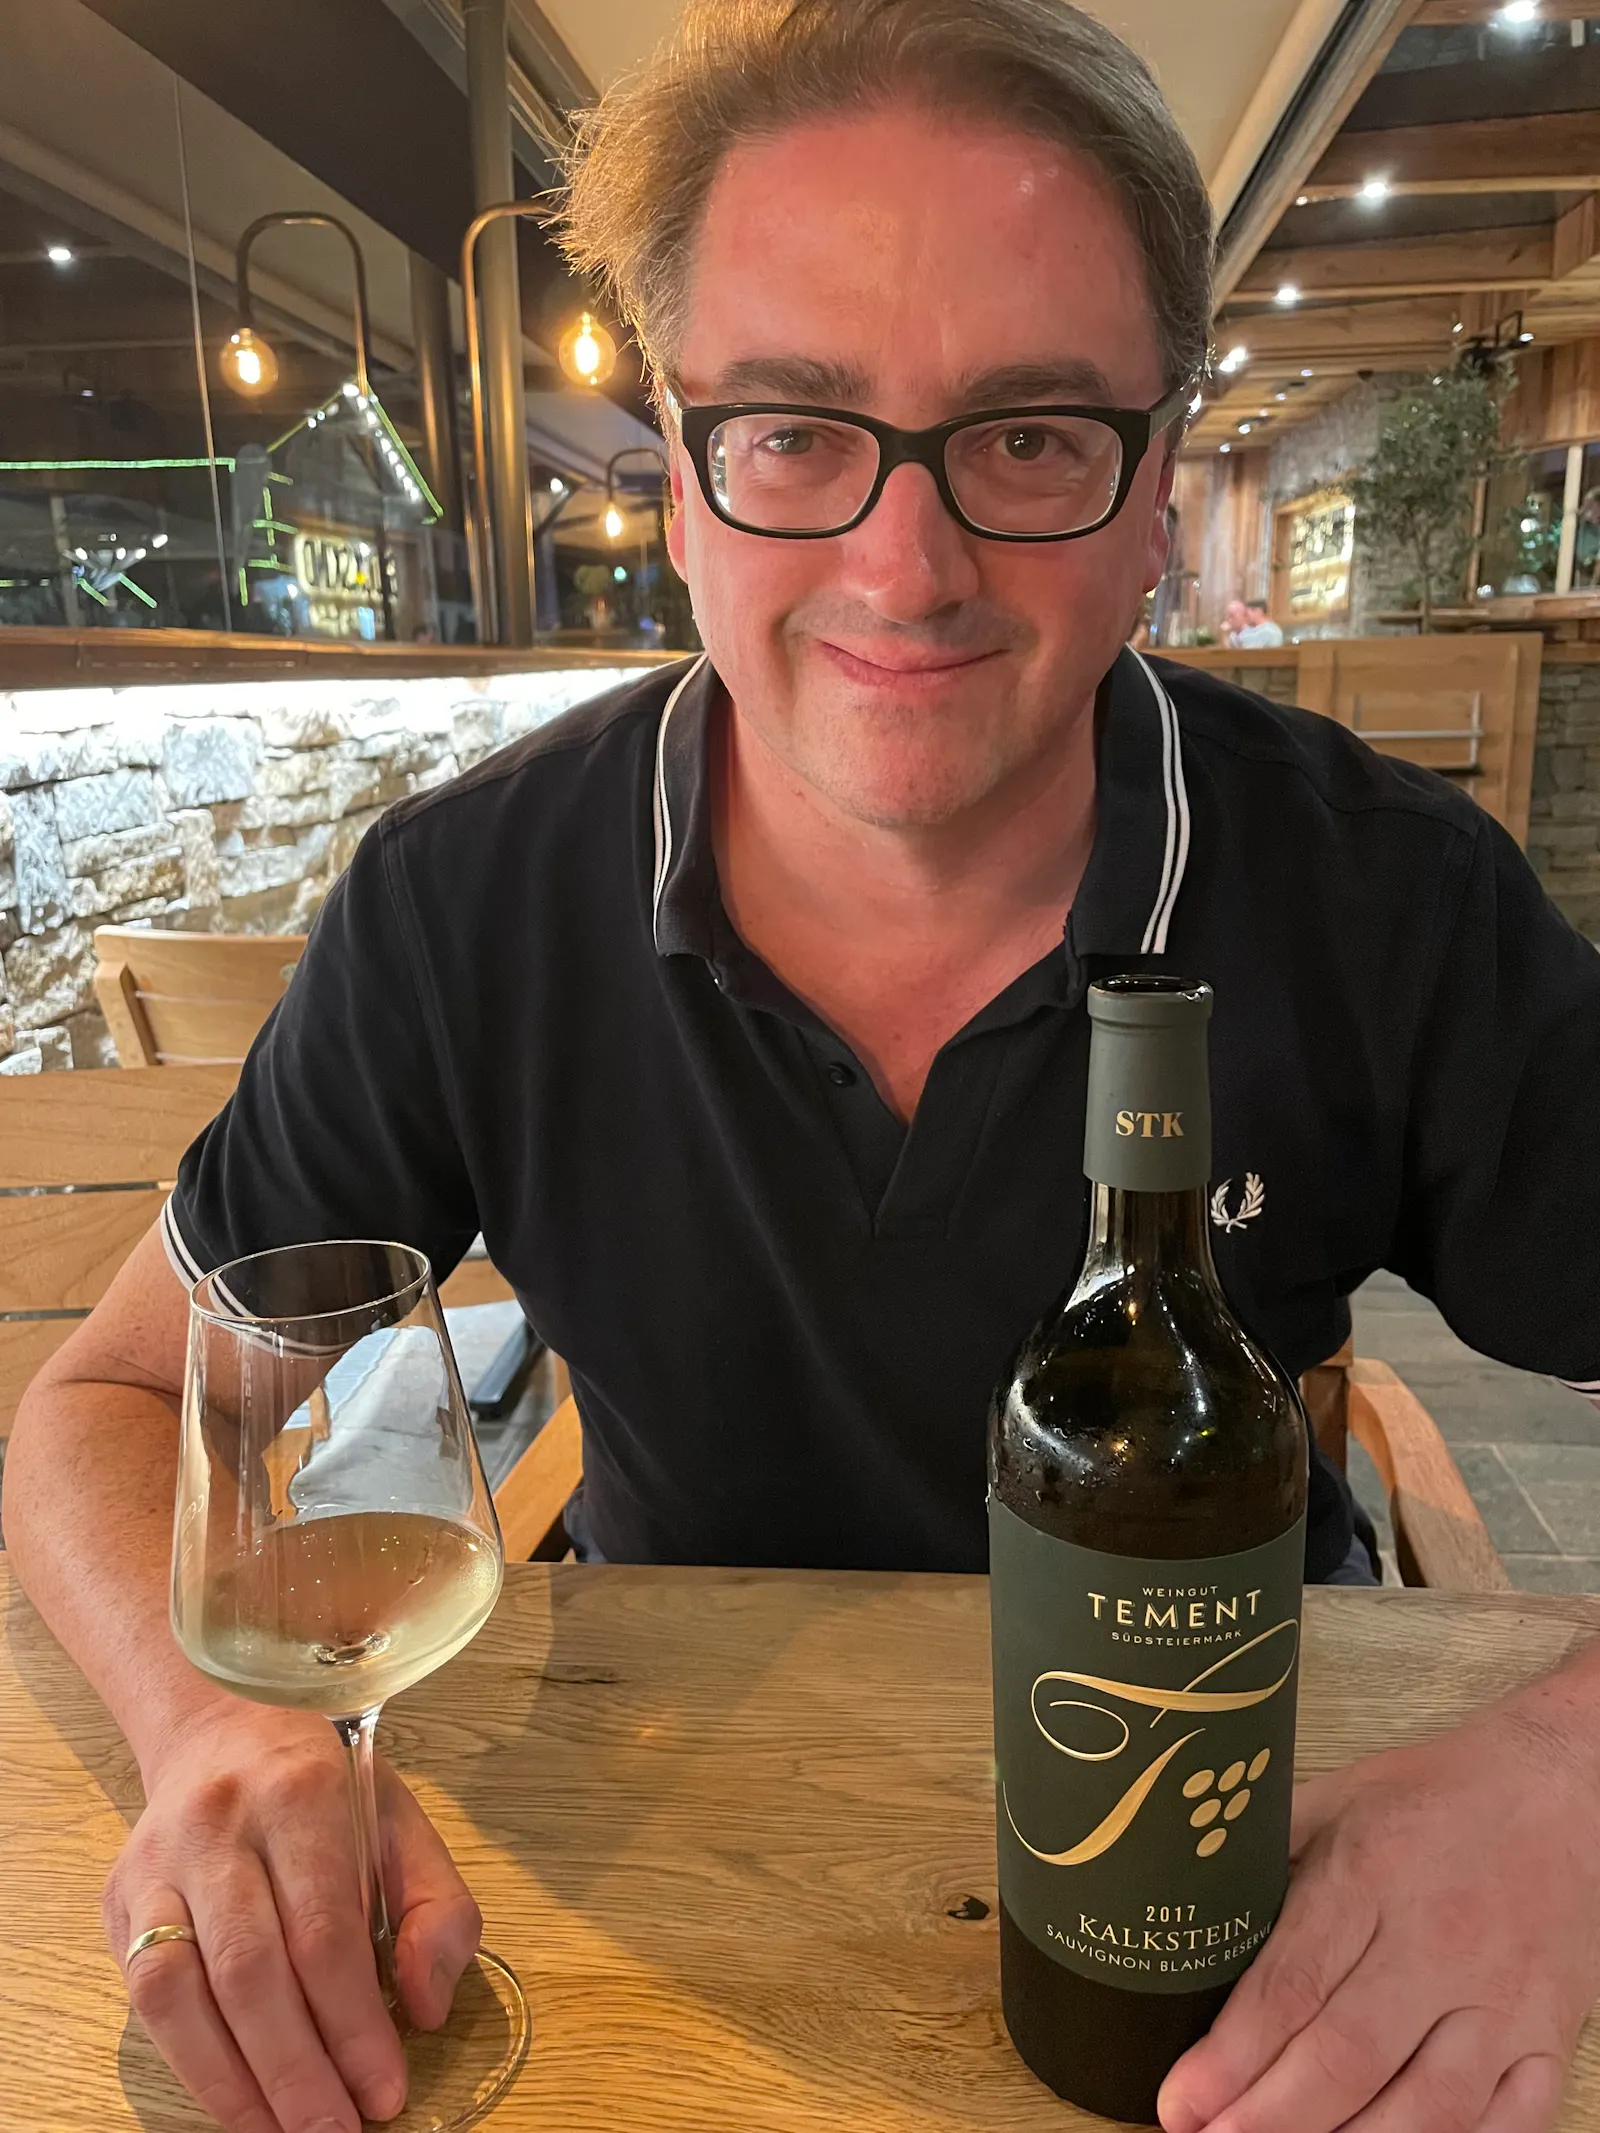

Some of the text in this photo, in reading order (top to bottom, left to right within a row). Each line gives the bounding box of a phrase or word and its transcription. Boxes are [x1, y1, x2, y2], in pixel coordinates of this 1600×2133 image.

[1115, 1110, 1184, 1137] STK
[1142, 1585, 1219, 1597] WEINGUT
[1087, 1589, 1262, 1629] TEMENT
[1111, 1629, 1242, 1646] SÜDSTEIERMARK
[1146, 1904, 1196, 1923] 2017
[1078, 1910, 1251, 1951] KALKSTEIN
[1046, 1923, 1151, 1971] SAUVIGNON
[1160, 1954, 1217, 1972] BLANC
